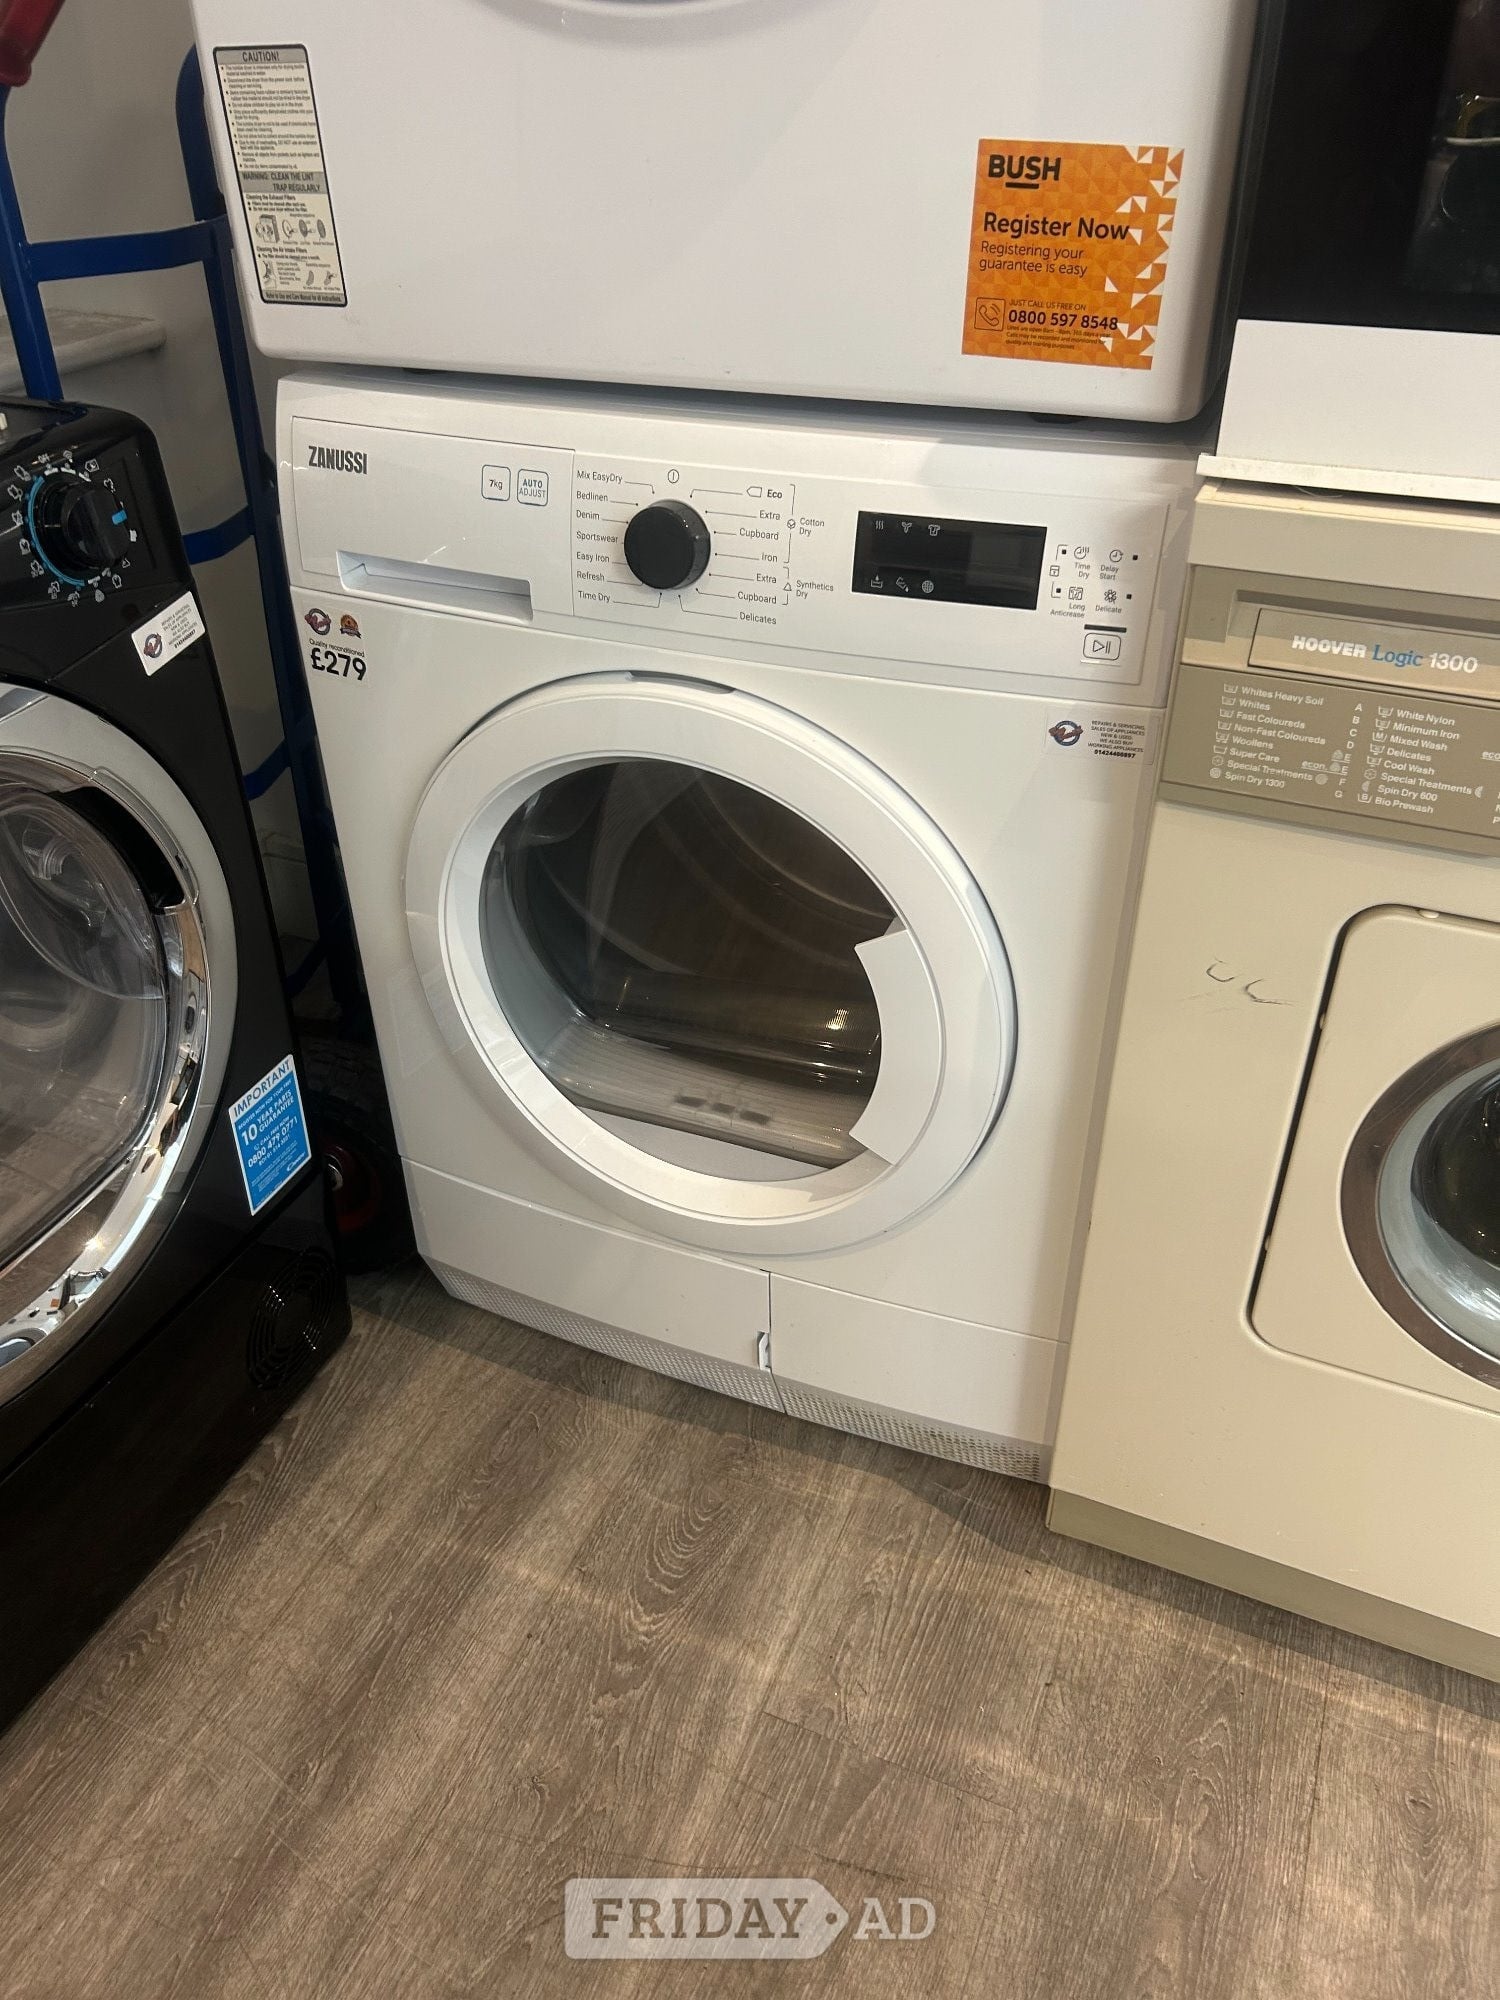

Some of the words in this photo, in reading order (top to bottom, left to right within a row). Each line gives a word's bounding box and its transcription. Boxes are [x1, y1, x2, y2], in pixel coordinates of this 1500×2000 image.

[242, 51, 280, 62] CAUTION!
[988, 154, 1062, 181] BUSH
[270, 172, 289, 180] CLEAN
[290, 172, 300, 180] THE
[983, 212, 1072, 238] Register
[1077, 217, 1130, 240] Now
[981, 241, 1050, 260] Registering
[1054, 248, 1084, 260] your
[979, 259, 1042, 272] guarantee
[1046, 260, 1055, 273] is
[1058, 263, 1088, 278] easy
[1008, 299, 1026, 307] JUST
[1028, 300, 1044, 308] CALL
[1056, 302, 1072, 310] FREE
[1074, 303, 1086, 311] ON
[1008, 310, 1046, 325] 0800
[1050, 313, 1078, 327] 597
[1080, 315, 1118, 330] 8548
[308, 445, 368, 474] ZANUSSI
[576, 470, 590, 480] Mix
[592, 471, 622, 484] EasyDry
[489, 479, 503, 490] 7kg
[523, 479, 543, 489] AUTO
[519, 488, 546, 498] ADJUST
[576, 491, 608, 501] Bedlinen
[767, 489, 782, 499] Eco
[576, 510, 600, 520] Denim
[760, 510, 780, 521] Extra
[800, 518, 824, 527] Cotton
[576, 531, 618, 543] Sportswear
[740, 528, 779, 541] Cupboard
[799, 527, 812, 537] Dry
[576, 552, 593, 562] Easy
[595, 554, 610, 562] Iron
[762, 552, 778, 562] Iron
[1074, 562, 1090, 570] Time
[1100, 564, 1119, 574] Delay
[576, 571, 604, 581] Refresh
[756, 573, 776, 584] Extra
[1078, 571, 1089, 580] Dry
[1100, 572, 1116, 580] Start
[796, 580, 834, 592] Synthetics
[578, 590, 597, 600] Time
[598, 593, 610, 603] Dry
[738, 592, 777, 604] Cupboard
[796, 590, 808, 600] Dry
[1069, 602, 1086, 611] Long
[1095, 604, 1122, 614] Delicate
[740, 612, 777, 625] Delicates
[1050, 609, 1085, 618] Anticrease
[309, 638, 328, 649] Quality
[1292, 635, 1368, 659] HOOVER
[1372, 644, 1424, 668] Logic
[1429, 652, 1479, 674] 1300
[310, 648, 366, 680] £279
[1242, 686, 1273, 699] Whites
[1275, 691, 1302, 705] Heavy
[1305, 695, 1324, 706] Soil
[1239, 699, 1270, 711] Whites
[1355, 703, 1363, 711] A
[1236, 711, 1256, 722] Fast
[1258, 714, 1306, 729] Coloureds
[1352, 716, 1360, 724] B
[1396, 709, 1424, 721] White
[1426, 713, 1455, 726] Nylon
[1234, 723, 1276, 737] Non-Fast
[1277, 730, 1326, 745] Coloureds
[1349, 728, 1358, 737] C
[1393, 722, 1438, 737] Minimum
[1440, 728, 1460, 740] Iron
[1232, 736, 1274, 750] Woollens
[1346, 741, 1354, 749] D
[1390, 735, 1419, 747] Mixed
[1421, 740, 1448, 751] Wash
[1229, 748, 1257, 760] Super
[1258, 752, 1280, 763] Care
[1344, 753, 1352, 762] E
[1387, 748, 1432, 762] Delicates
[1227, 759, 1261, 773] Special
[1262, 765, 1313, 781] Treatments
[1302, 760, 1328, 771] econ.
[1342, 766, 1349, 774] E
[1384, 760, 1407, 771] Cool
[1408, 764, 1435, 776] Wash
[1225, 771, 1246, 783] Spin
[1246, 775, 1263, 786] Dry
[1265, 778, 1285, 788] 1300
[1338, 778, 1347, 786] F
[1381, 772, 1416, 786] Special
[1418, 778, 1472, 795] Treatments
[1334, 790, 1343, 799] G
[1378, 784, 1400, 796] Spin
[1401, 788, 1419, 800] Dry
[1420, 792, 1438, 802] 600
[1375, 796, 1391, 806] Bio
[1392, 800, 1434, 814] Prewash
[234, 1061, 290, 1118] IMPORTANT
[241, 1124, 258, 1146] 10
[258, 1106, 274, 1125] YEAR
[274, 1089, 292, 1109] PARTS
[259, 1095, 294, 1132] GUARANTEE
[248, 1146, 266, 1168] 0800
